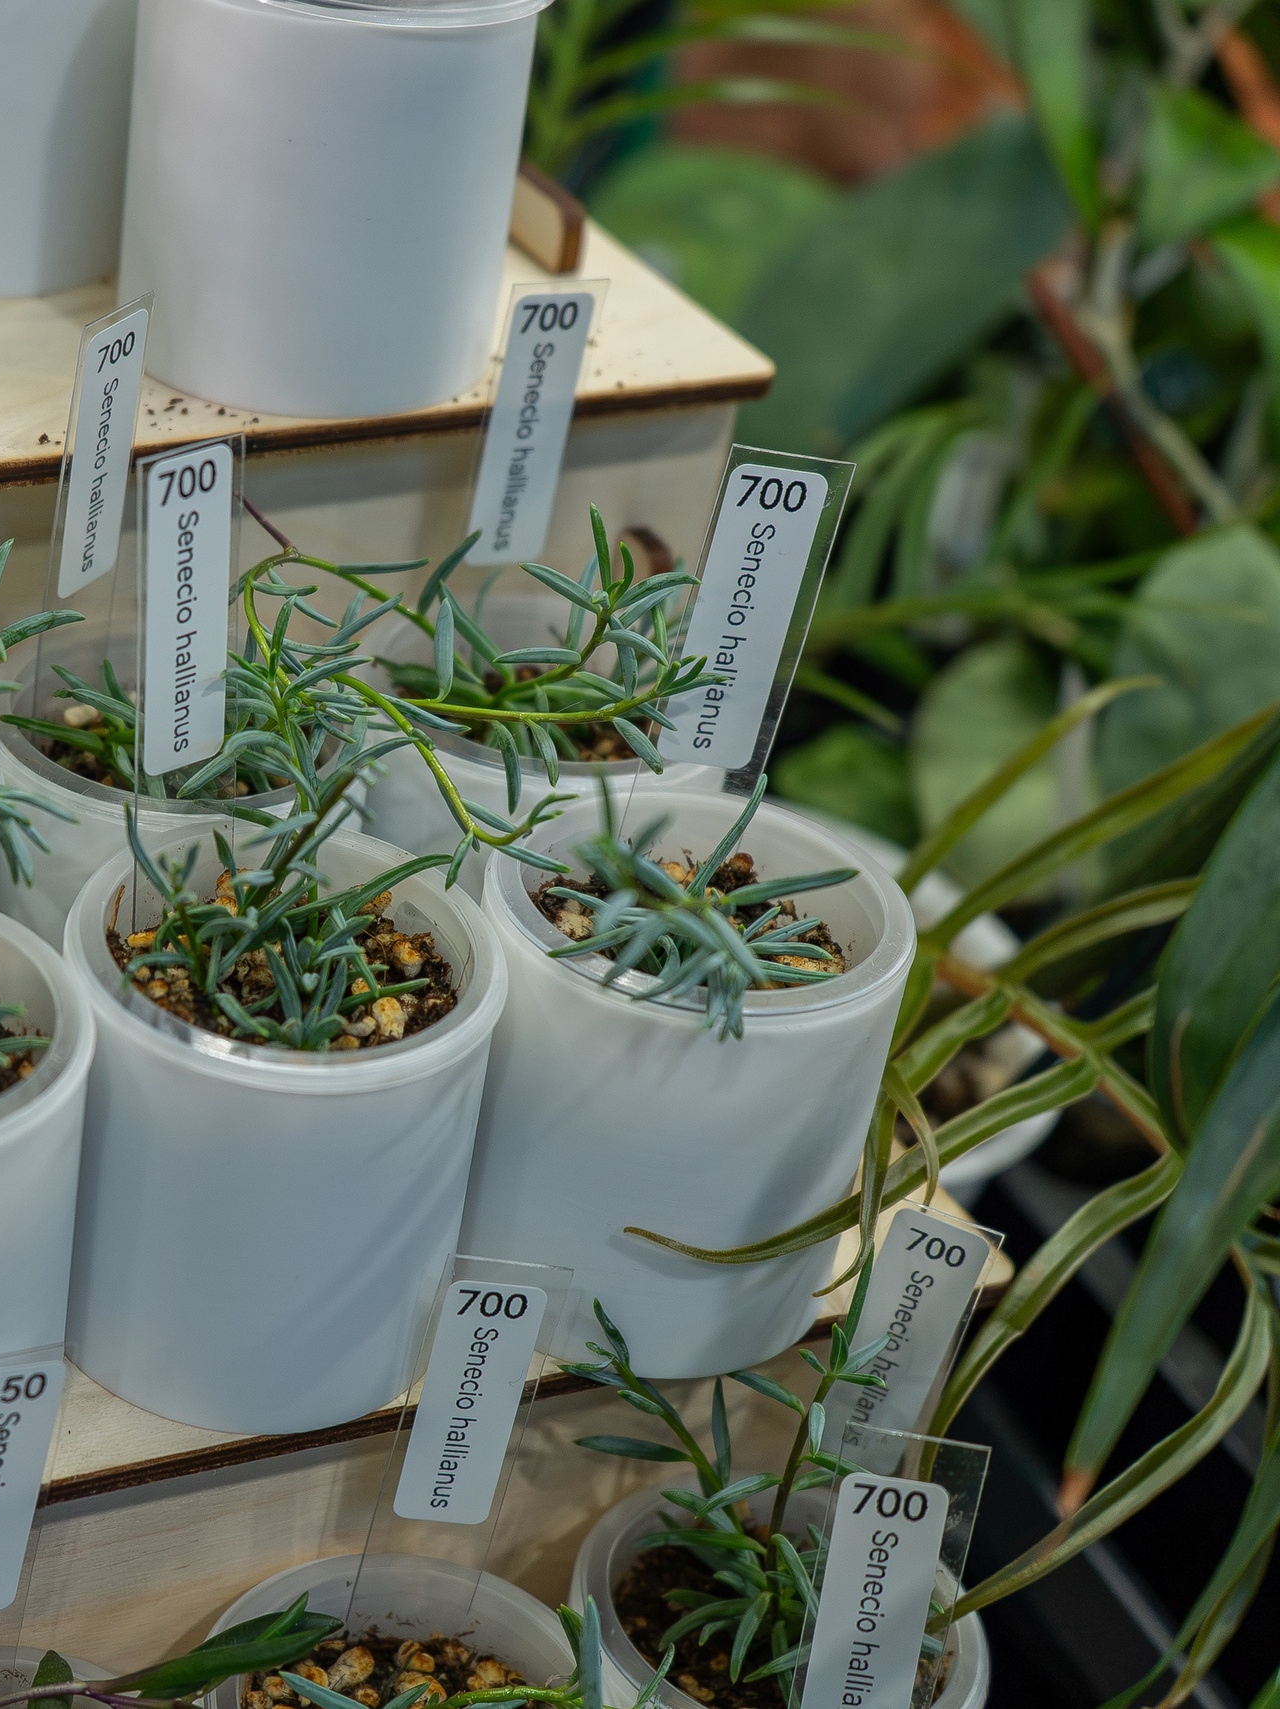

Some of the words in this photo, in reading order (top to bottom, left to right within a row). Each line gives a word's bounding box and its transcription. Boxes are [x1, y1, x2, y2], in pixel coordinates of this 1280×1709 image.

[97, 331, 135, 373] 700
[521, 302, 578, 333] 700
[94, 378, 119, 470] Senecio
[516, 342, 554, 439] Senecio
[81, 472, 108, 573] hallianus
[159, 460, 217, 507] 700
[493, 446, 535, 551] hallianus
[736, 474, 808, 513] 700
[177, 511, 199, 624] Senecio
[727, 522, 776, 626] Senecio
[174, 630, 198, 753] hallianus
[693, 635, 747, 749] halianus
[905, 1227, 966, 1268] 700
[457, 1289, 528, 1319] 700
[887, 1270, 934, 1351] Senecio
[456, 1327, 499, 1410] Senecio
[430, 1416, 477, 1508] hallianus
[852, 1483, 928, 1522] 700
[856, 1530, 899, 1633] Senecio
[842, 1640, 880, 1707] hallia
